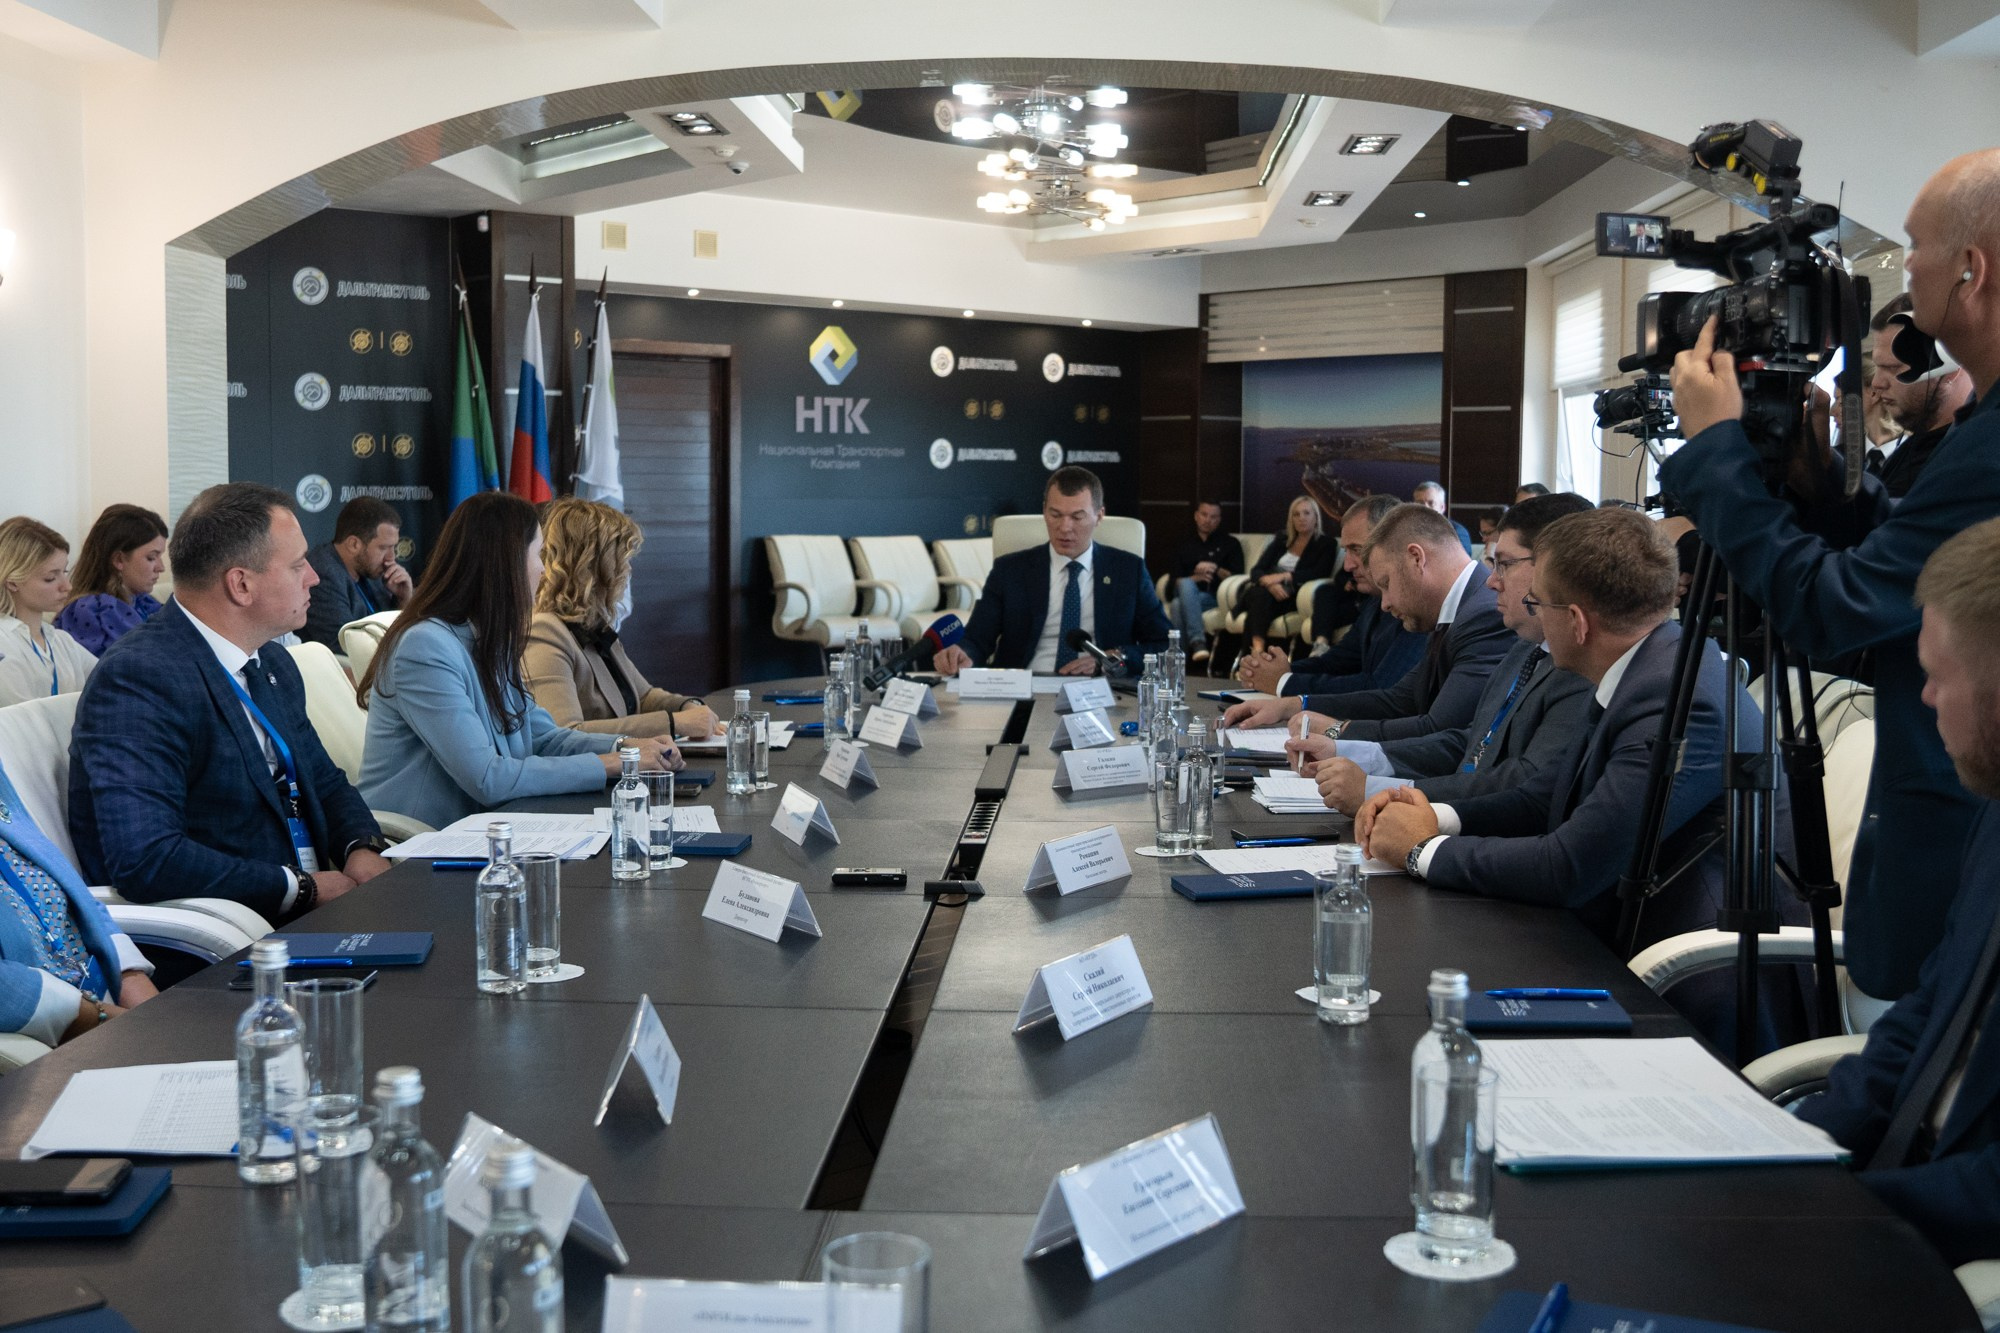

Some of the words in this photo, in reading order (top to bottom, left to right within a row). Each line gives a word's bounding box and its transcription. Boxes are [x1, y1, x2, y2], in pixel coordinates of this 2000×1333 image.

[337, 280, 431, 300] ДАЛЬТРАНСУГОЛЬ
[339, 385, 433, 402] ДАЛЬТРАНСУГОЛЬ
[795, 395, 871, 435] НТК
[758, 443, 835, 457] Национальная
[836, 444, 906, 459] Транспортная
[810, 457, 861, 470] Компания
[721, 895, 736, 907] Елена
[1072, 984, 1093, 1001] Серей
